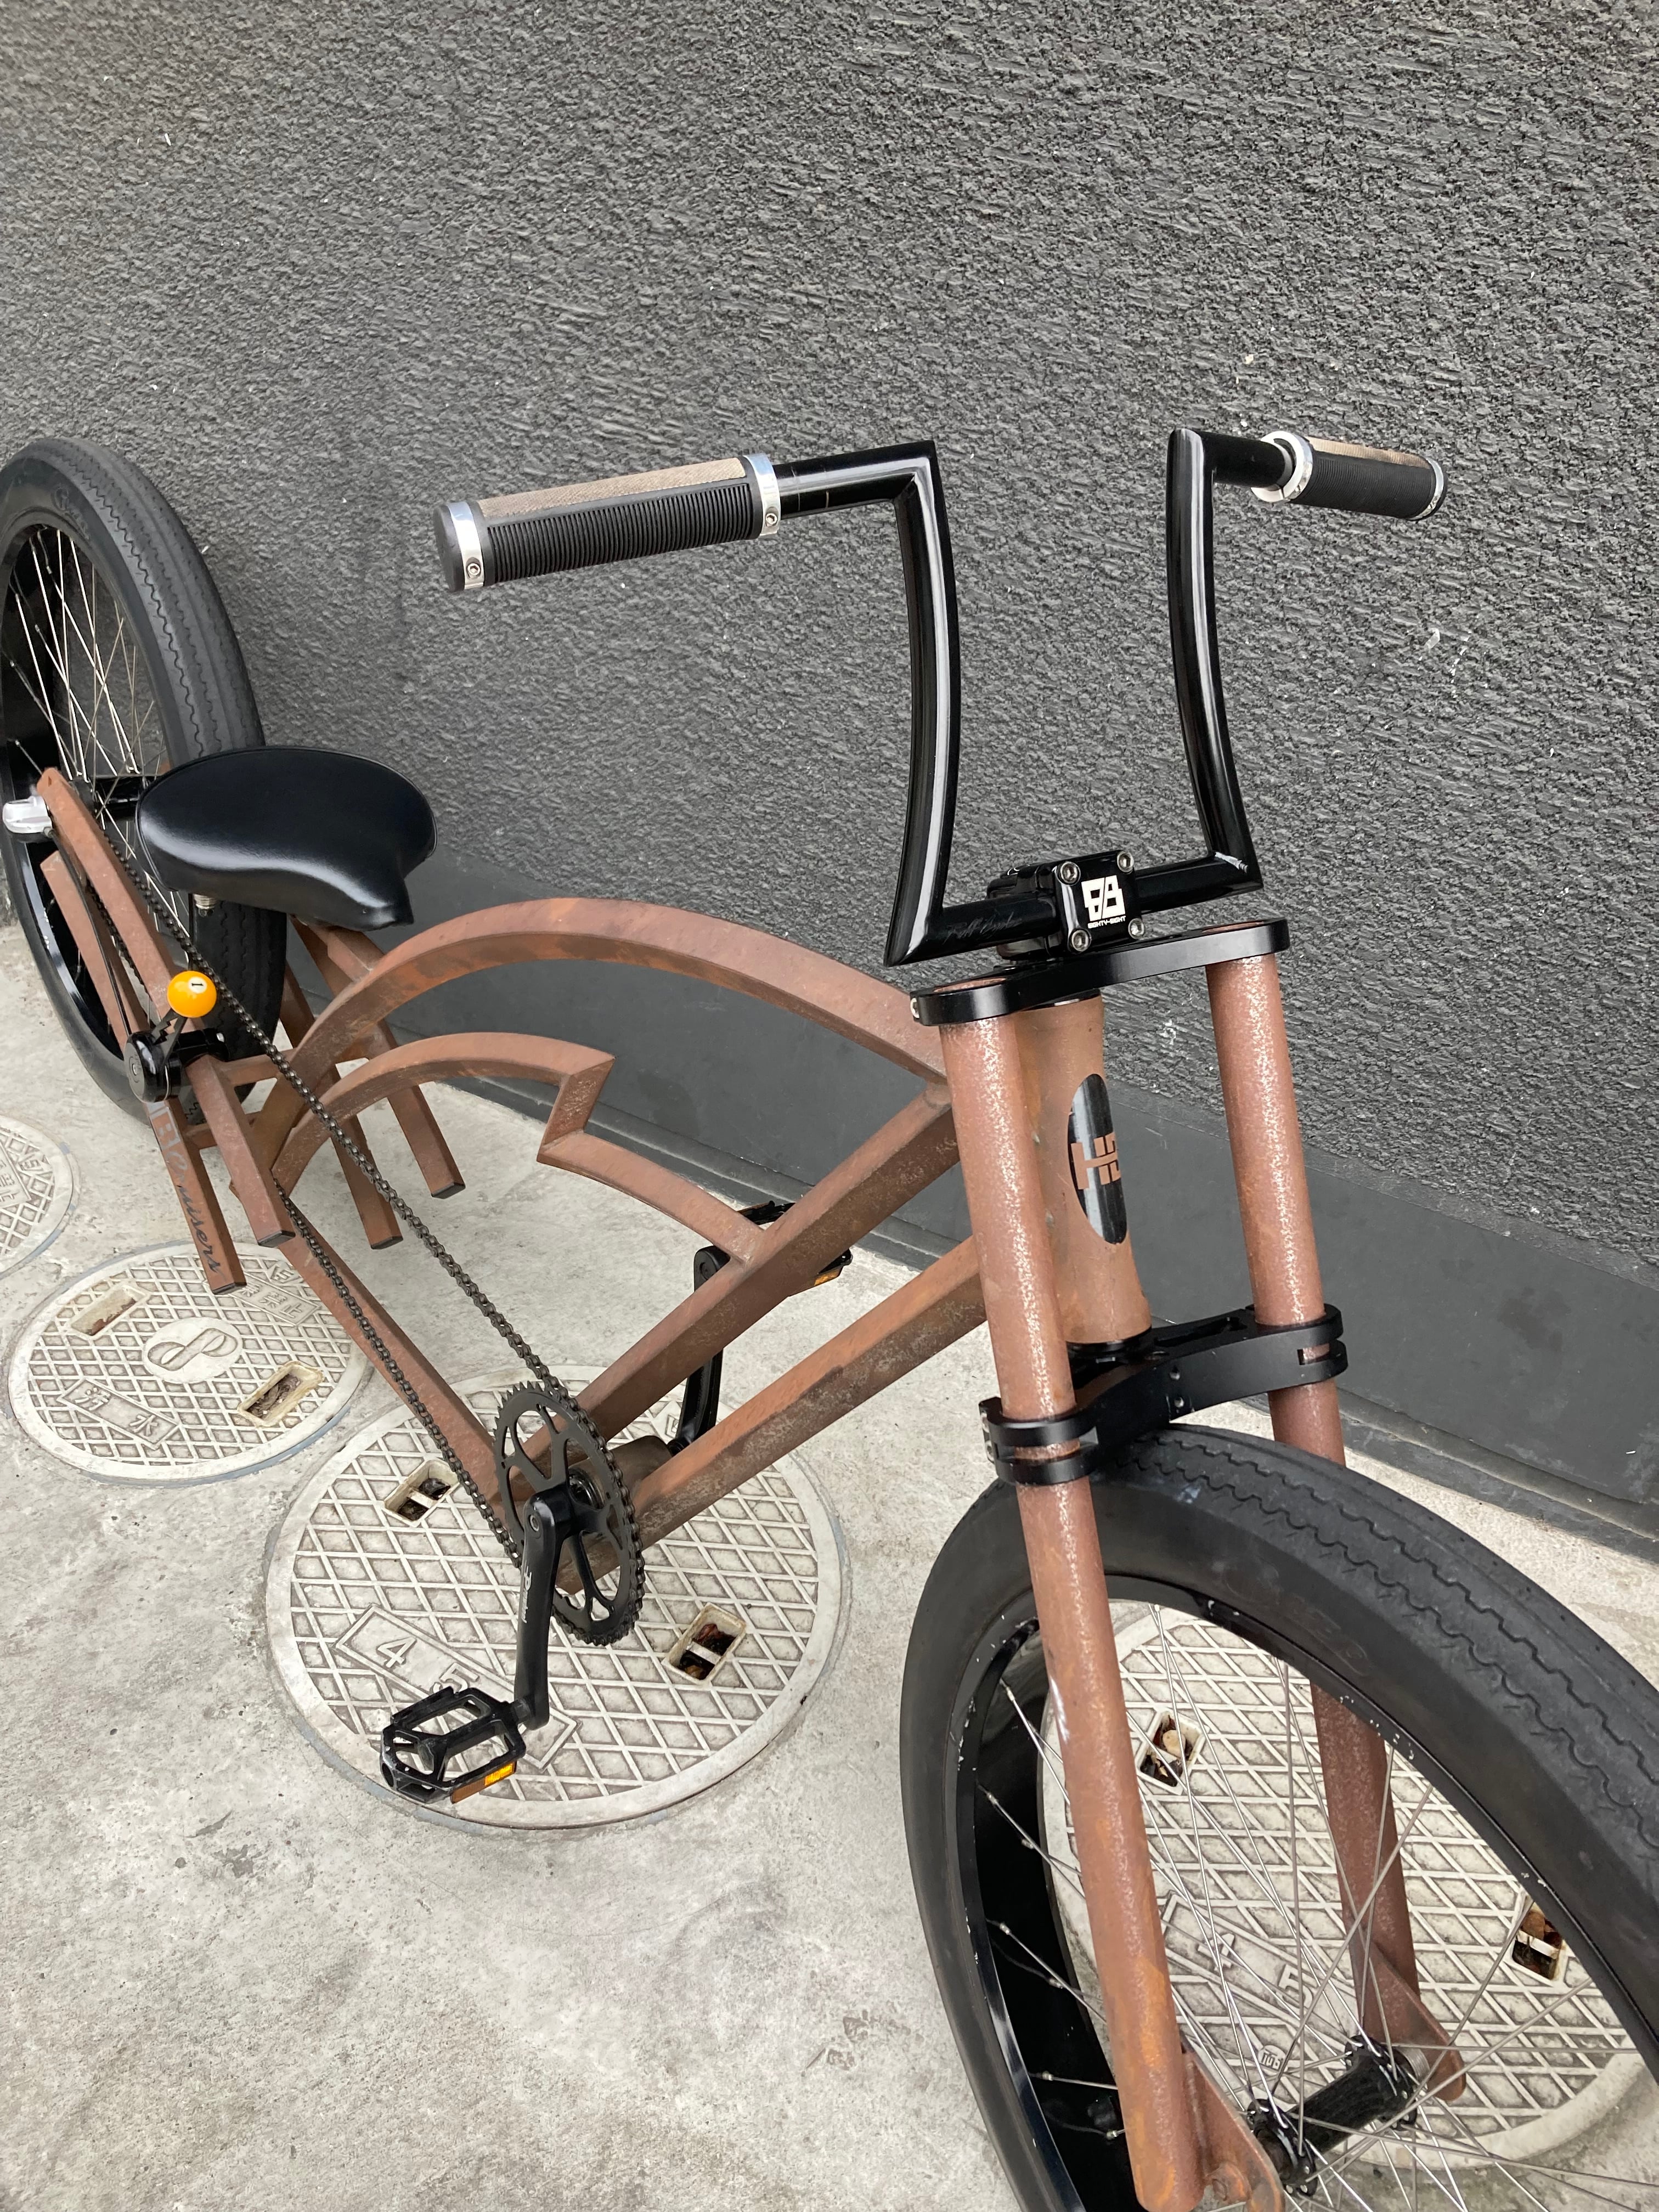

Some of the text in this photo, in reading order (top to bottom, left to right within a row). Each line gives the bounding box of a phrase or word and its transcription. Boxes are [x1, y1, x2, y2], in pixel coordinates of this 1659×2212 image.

[1088, 916, 1126, 929] EIGHTY-EIGHT
[165, 1151, 221, 1273] Cruisers
[75, 1386, 159, 1437] 汚水
